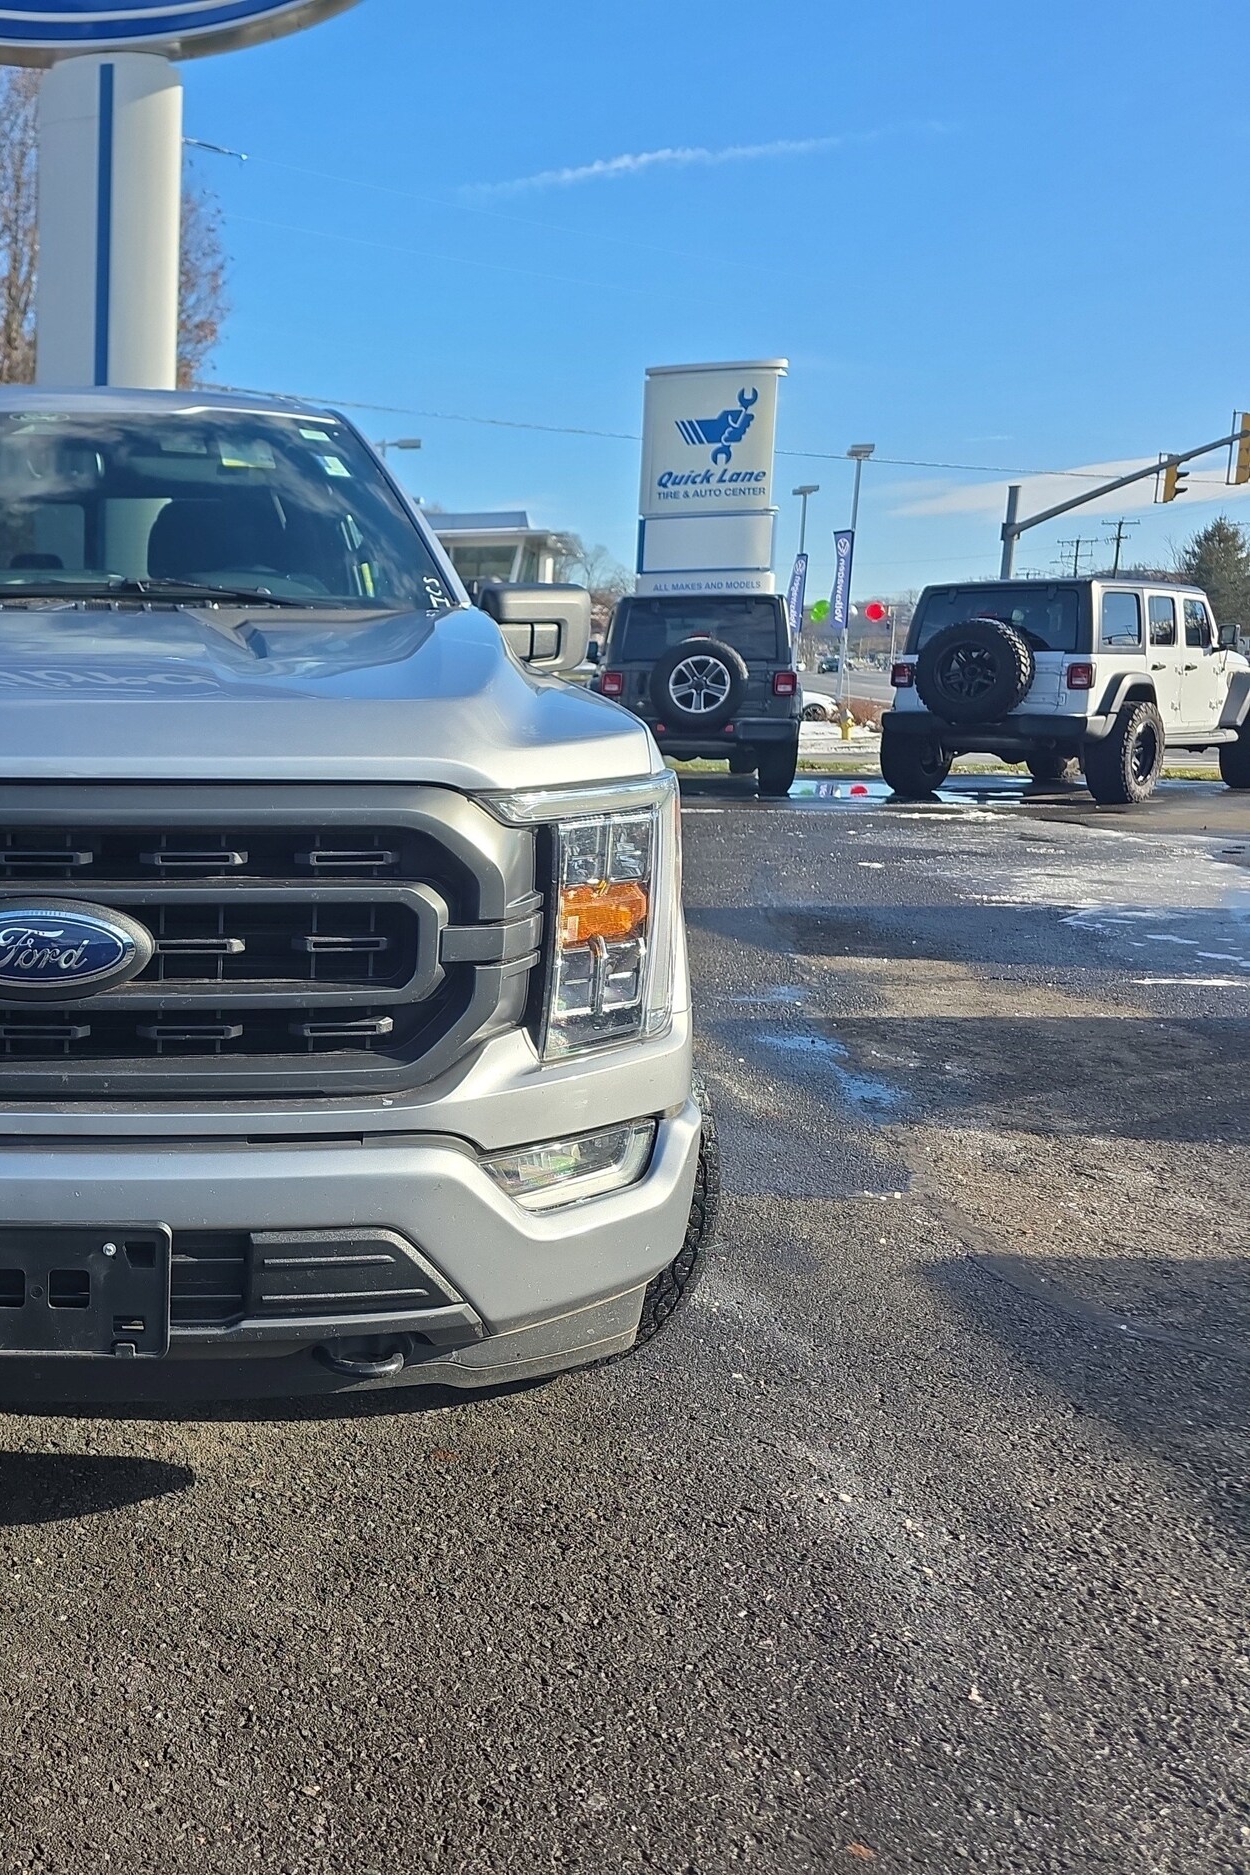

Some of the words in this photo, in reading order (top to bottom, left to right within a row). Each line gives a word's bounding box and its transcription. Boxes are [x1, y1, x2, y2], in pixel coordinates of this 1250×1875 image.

[657, 469, 715, 489] Quick
[717, 468, 766, 484] Lane
[657, 490, 680, 500] TIRE
[682, 489, 690, 498] &
[692, 488, 722, 498] AUTO
[724, 486, 766, 497] CENTER
[653, 583, 669, 592] ALL
[671, 582, 702, 591] MAKES
[704, 581, 724, 590] AND
[726, 580, 762, 589] MODELS
